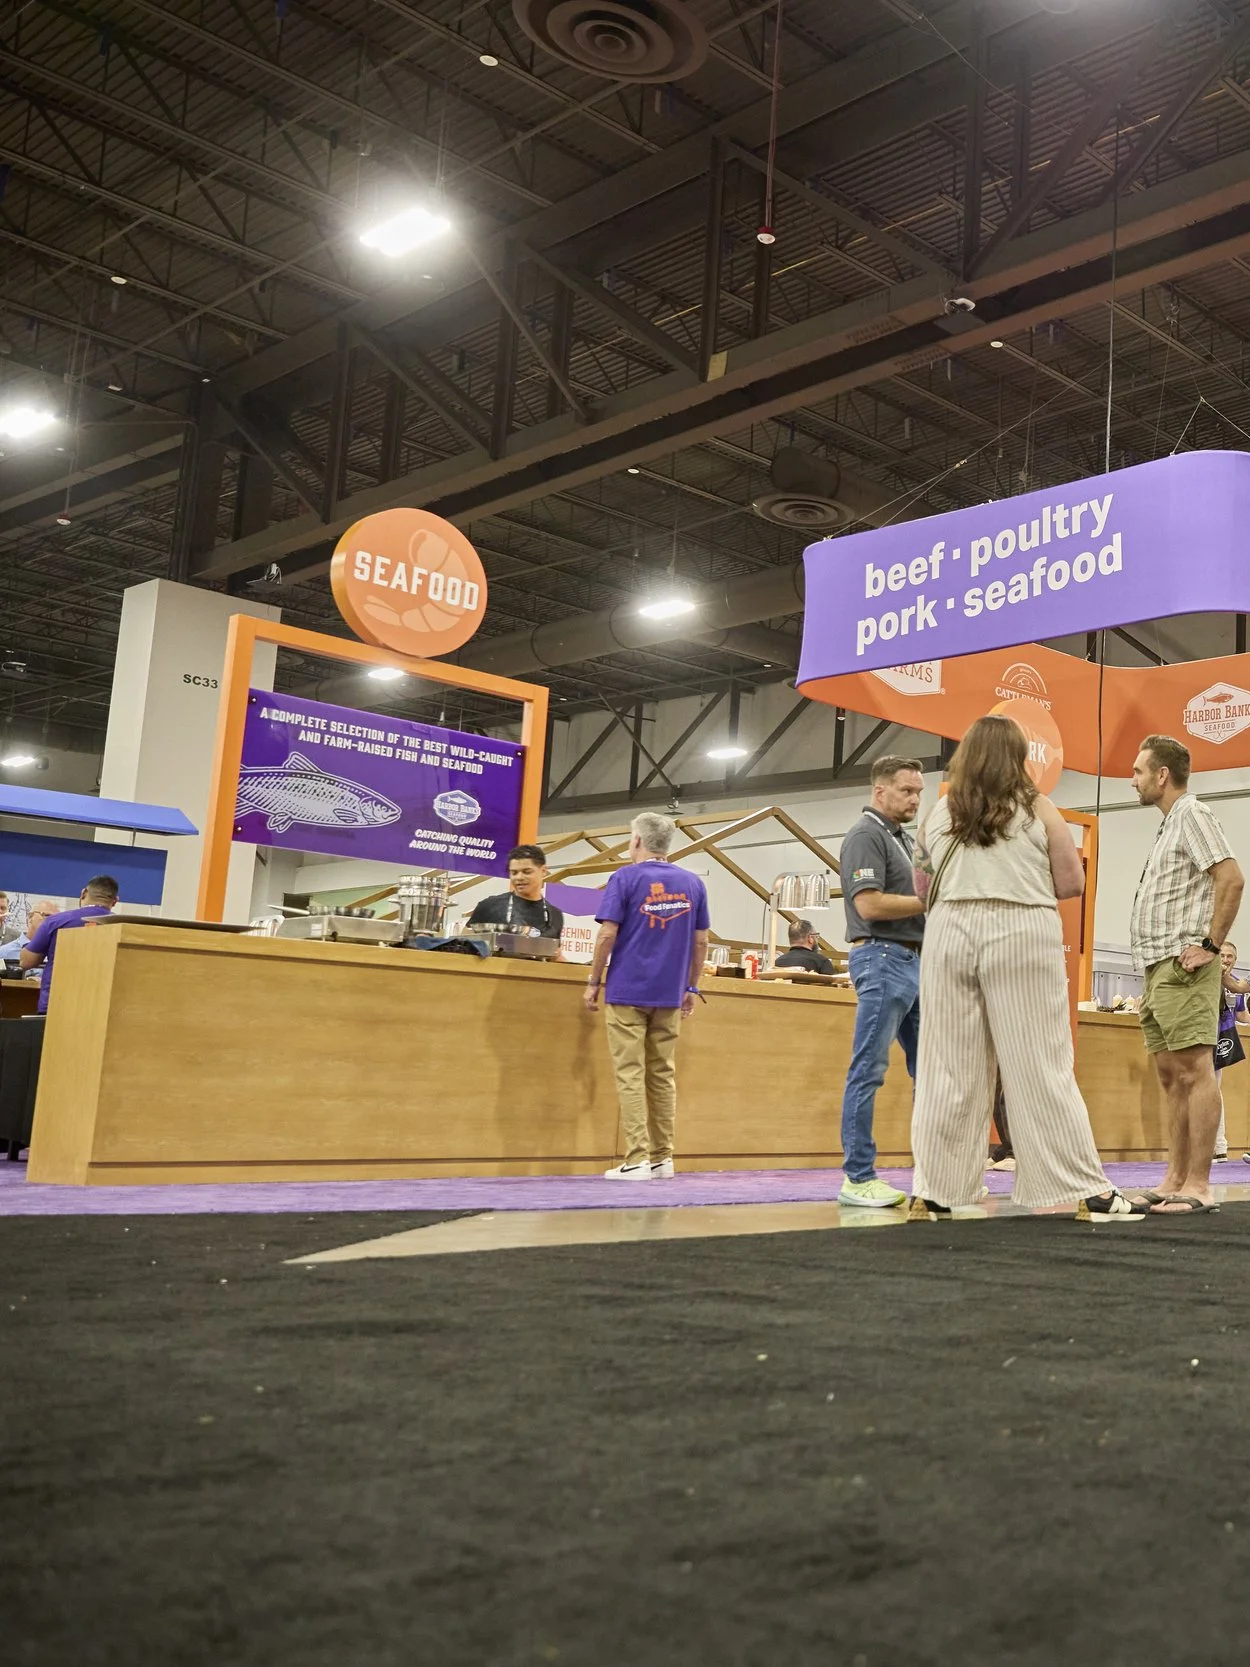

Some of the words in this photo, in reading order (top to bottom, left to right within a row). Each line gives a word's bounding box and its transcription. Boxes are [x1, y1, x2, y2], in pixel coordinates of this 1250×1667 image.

[865, 541, 945, 598] beef
[970, 493, 1114, 577] poultry
[353, 550, 480, 611] SEAFOOD
[856, 594, 938, 656] pork
[963, 532, 1123, 618] seafood
[183, 674, 218, 689] SC33
[893, 664, 933, 683] RMS
[1184, 708, 1222, 724] HARBOR
[1204, 721, 1236, 731] SEAFOOD
[259, 707, 268, 719] A
[271, 708, 327, 730] COMPLETE
[329, 720, 385, 742] SELECTION
[387, 732, 400, 744] OF
[402, 735, 421, 749] THE
[423, 740, 448, 754] BEST
[449, 745, 514, 767] WILD-CAUGHT
[298, 729, 321, 744] AND
[323, 735, 393, 758] FARM-RAISED
[395, 748, 418, 762] FISH
[419, 753, 440, 767] AND
[442, 758, 484, 775] SEAFOOD
[1028, 740, 1047, 764] RK
[414, 828, 458, 843] CATCHING
[458, 835, 495, 848] QUALITY
[409, 839, 447, 853] AROUND
[448, 845, 466, 855] THE
[465, 847, 497, 860] WORLD
[644, 903, 662, 911] Food
[561, 928, 591, 939] BEHIND
[561, 941, 573, 951] HE
[575, 942, 594, 953] BITE
